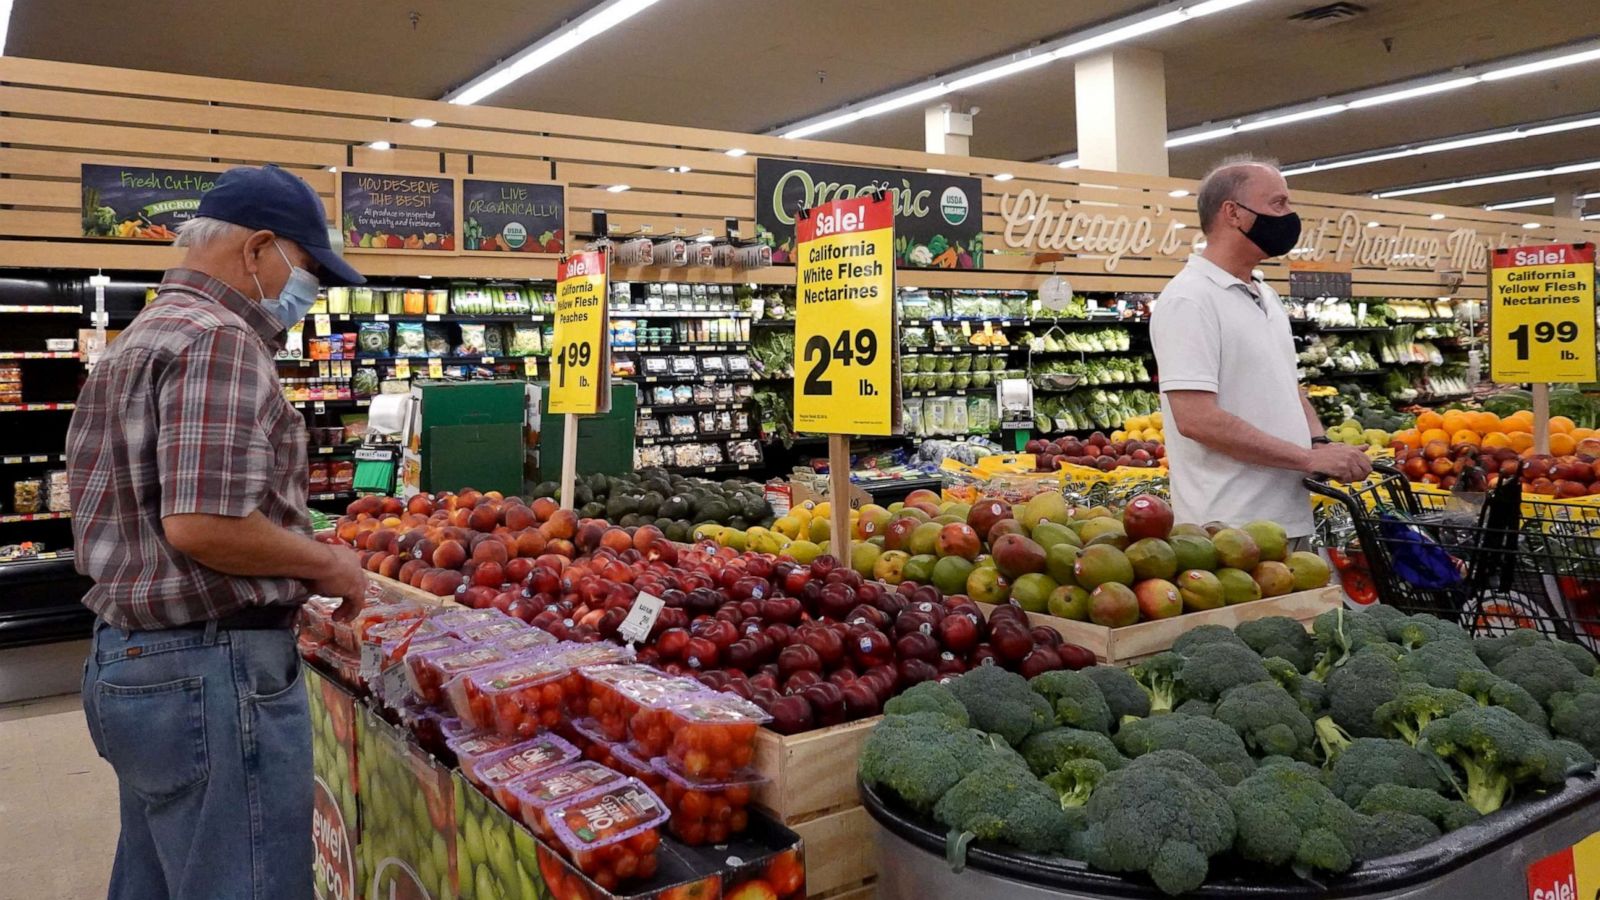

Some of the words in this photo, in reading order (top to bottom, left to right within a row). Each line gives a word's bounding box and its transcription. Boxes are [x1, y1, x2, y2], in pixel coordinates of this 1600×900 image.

[120, 170, 162, 189] Fresh
[164, 174, 193, 191] Cut
[358, 177, 380, 191] YOU
[382, 179, 440, 194] DESERVE
[368, 192, 393, 207] THE
[501, 187, 528, 200] LIVE
[946, 195, 963, 205] USDA
[372, 207, 397, 218] produce
[406, 211, 436, 219] inspected
[468, 199, 558, 219] ORGANICALLY
[358, 215, 368, 224] for
[369, 217, 395, 229] quality
[815, 206, 865, 237] Sale!
[1000, 188, 1182, 273] Chicago's
[1335, 211, 1441, 270] Produce
[809, 240, 875, 263] California
[1514, 248, 1566, 266] Sale!
[803, 266, 833, 284] White
[838, 260, 883, 279] Flesh
[1507, 269, 1576, 282] California
[561, 281, 594, 297] California
[804, 284, 878, 304] Nectarines
[1498, 284, 1540, 294] Yellow
[1544, 281, 1587, 292] Flesh
[574, 295, 599, 308] Flesh
[1503, 294, 1580, 306] Nectarines
[559, 312, 588, 324] Peaches
[1560, 350, 1580, 361] lb.
[579, 375, 590, 387] lb.
[859, 379, 878, 396] lb.
[580, 804, 614, 831] ONE
[312, 807, 343, 864] ewel
